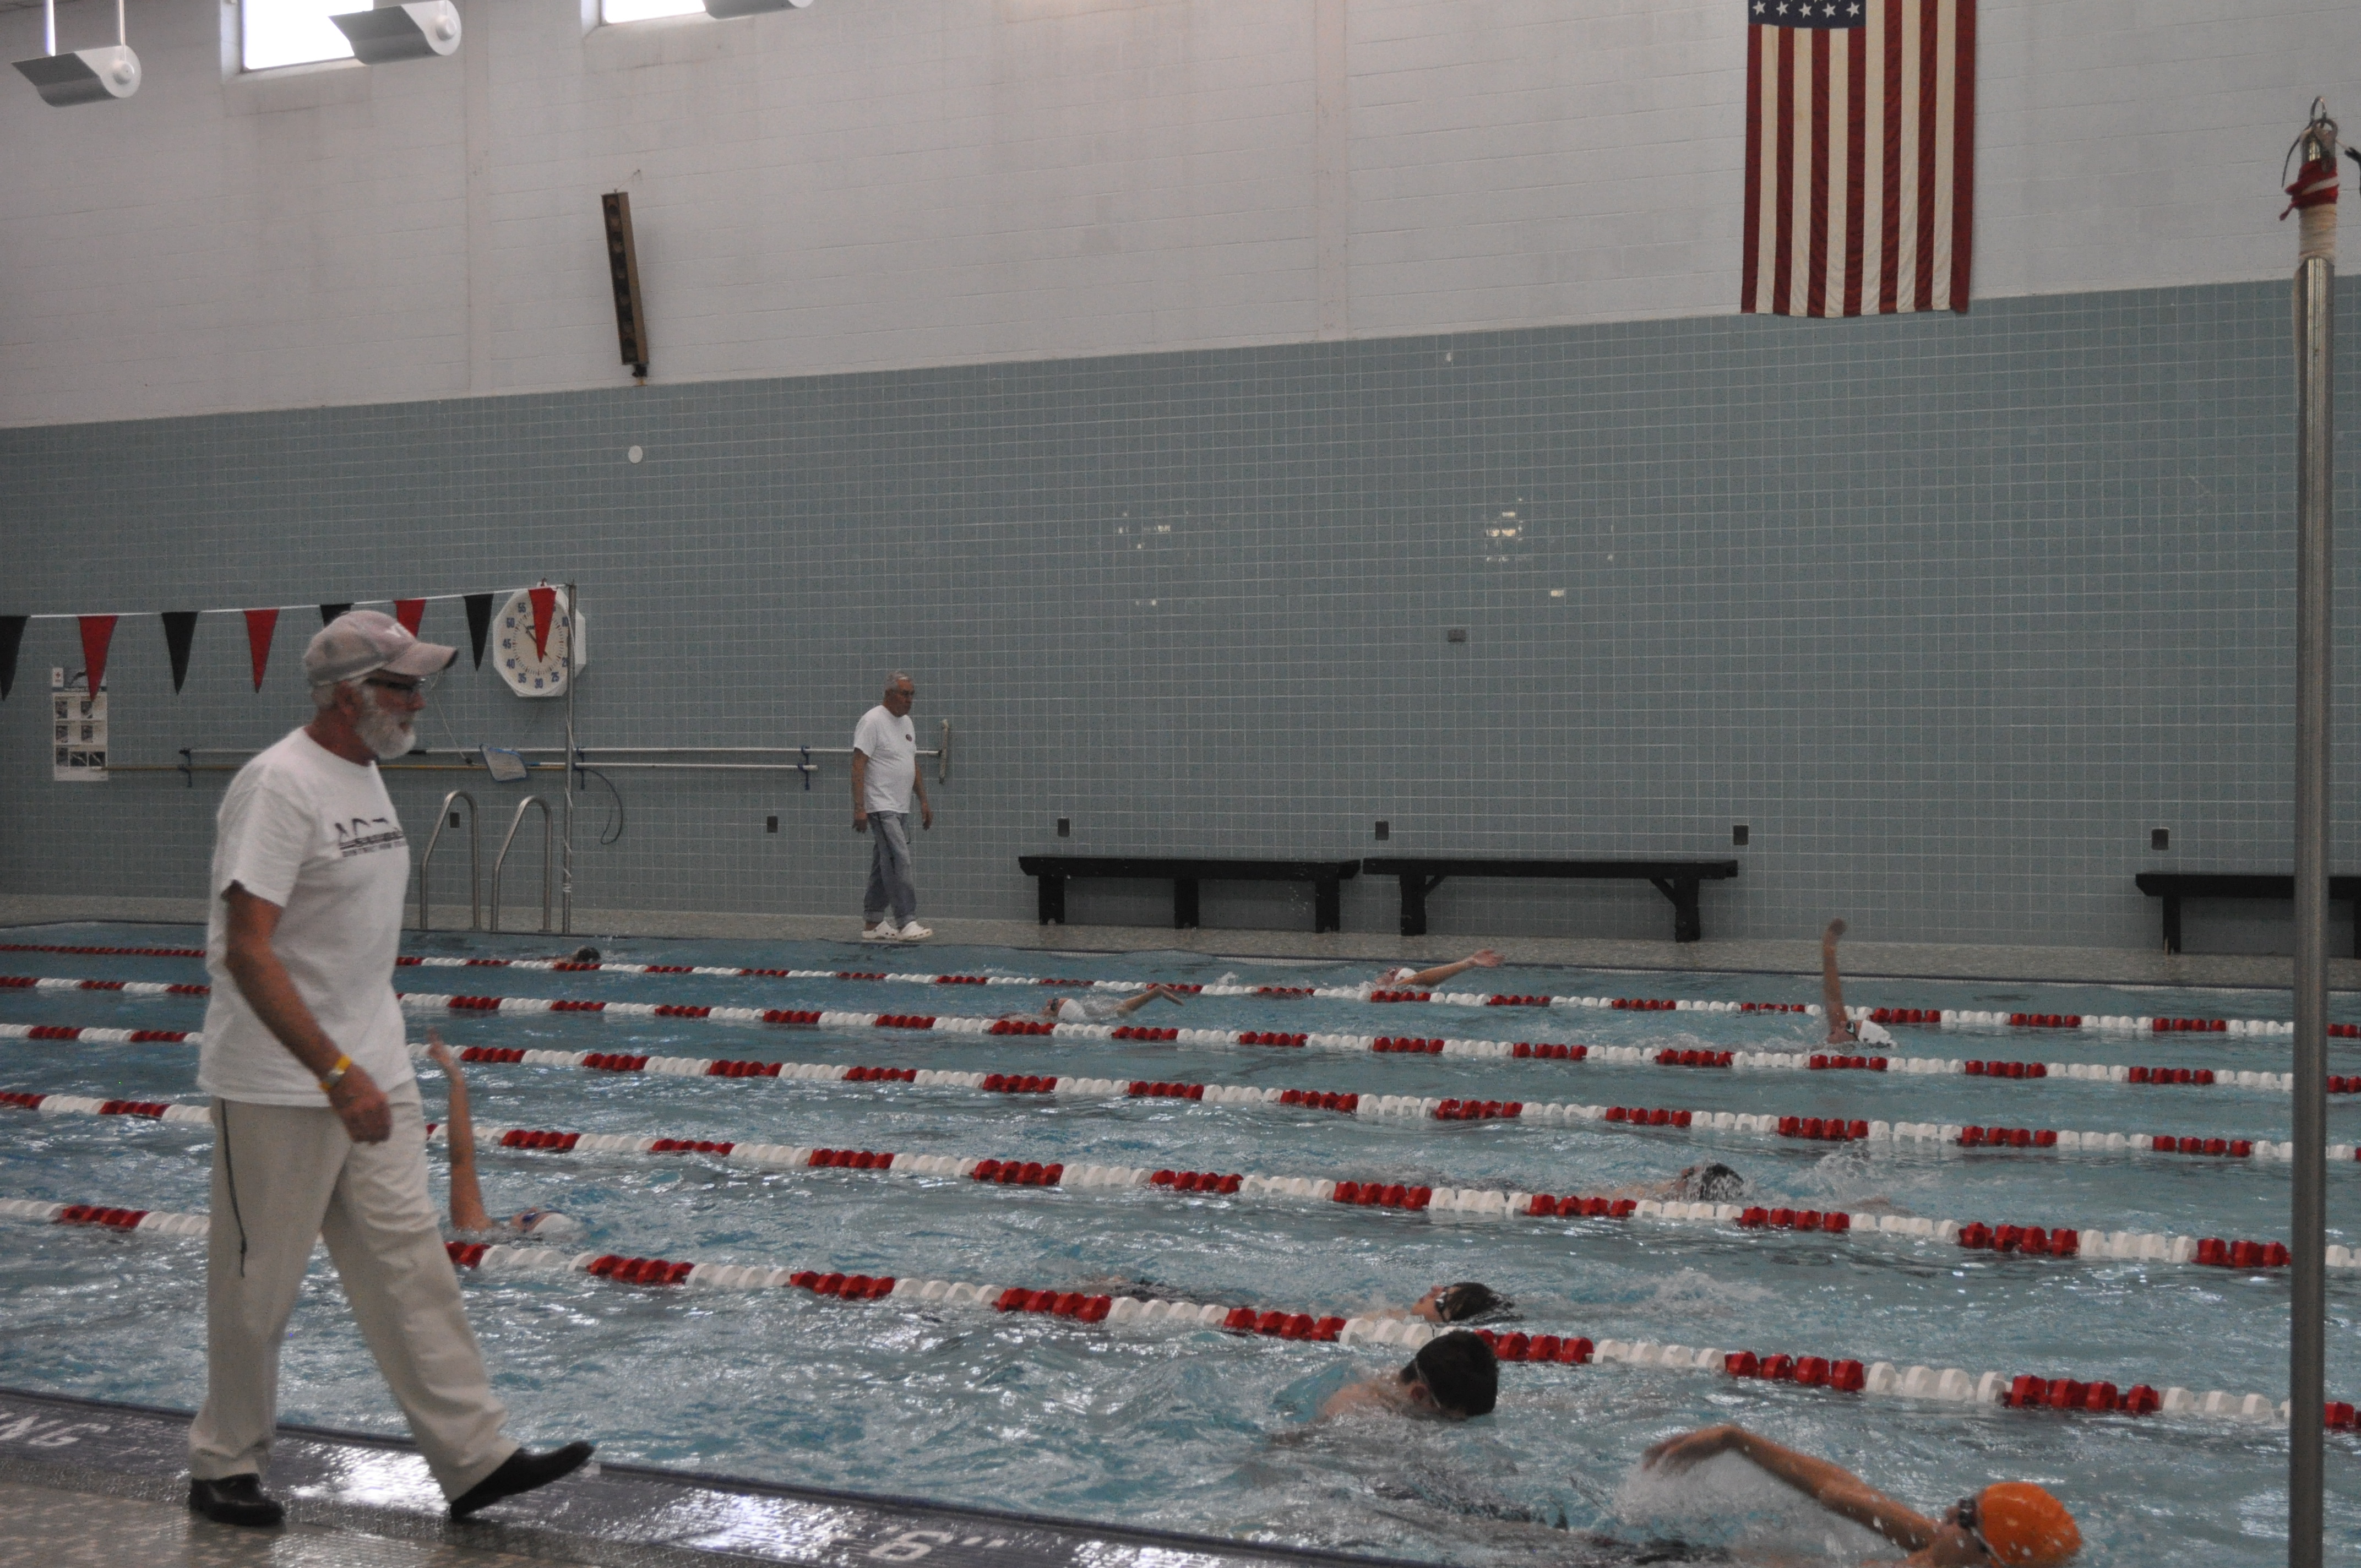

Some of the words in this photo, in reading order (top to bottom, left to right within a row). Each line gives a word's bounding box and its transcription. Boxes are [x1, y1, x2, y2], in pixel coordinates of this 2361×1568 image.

[518, 602, 526, 613] 55
[507, 618, 515, 628] 50
[503, 639, 512, 649] 45
[507, 658, 515, 669] 40
[518, 673, 527, 683] 35
[552, 672, 559, 682] 25
[535, 678, 543, 689] 30
